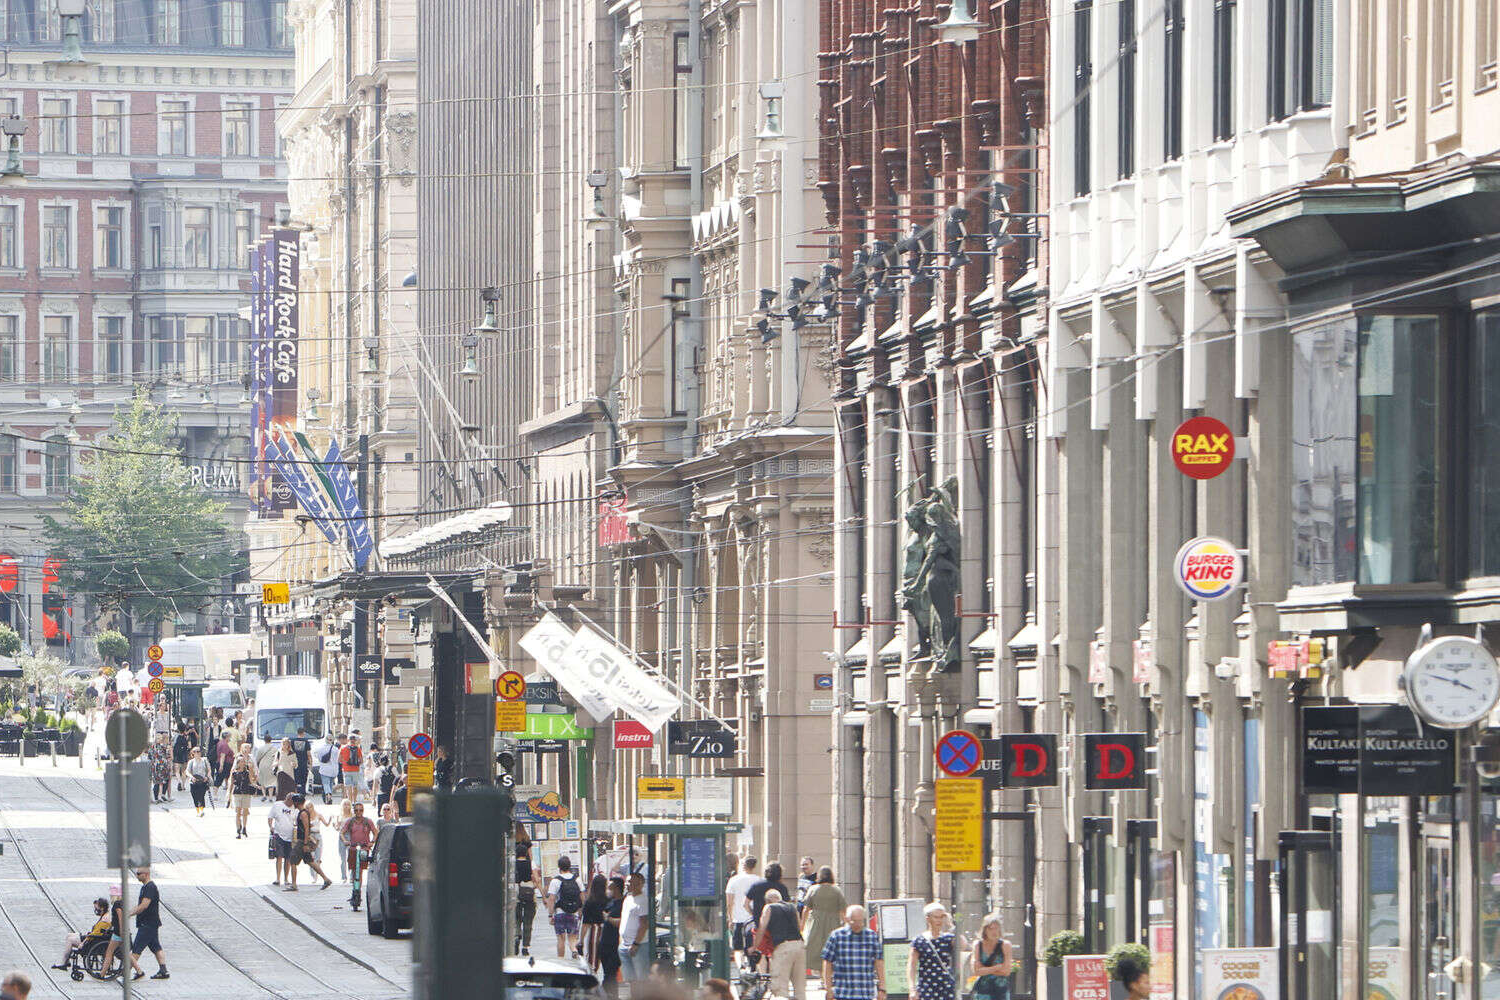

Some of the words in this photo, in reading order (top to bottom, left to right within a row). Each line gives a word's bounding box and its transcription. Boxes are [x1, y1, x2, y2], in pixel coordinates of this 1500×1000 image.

[278, 240, 298, 291] Hard
[274, 292, 297, 338] Rock
[274, 340, 295, 383] Cafe
[1176, 433, 1229, 454] RAX
[1187, 555, 1235, 566] BURGER
[1185, 566, 1235, 581] KING
[263, 588, 273, 602] 10
[150, 682, 161, 690] 20
[617, 733, 651, 742] instru
[690, 736, 723, 754] Zio
[1365, 738, 1449, 750] KULTAKELLO
